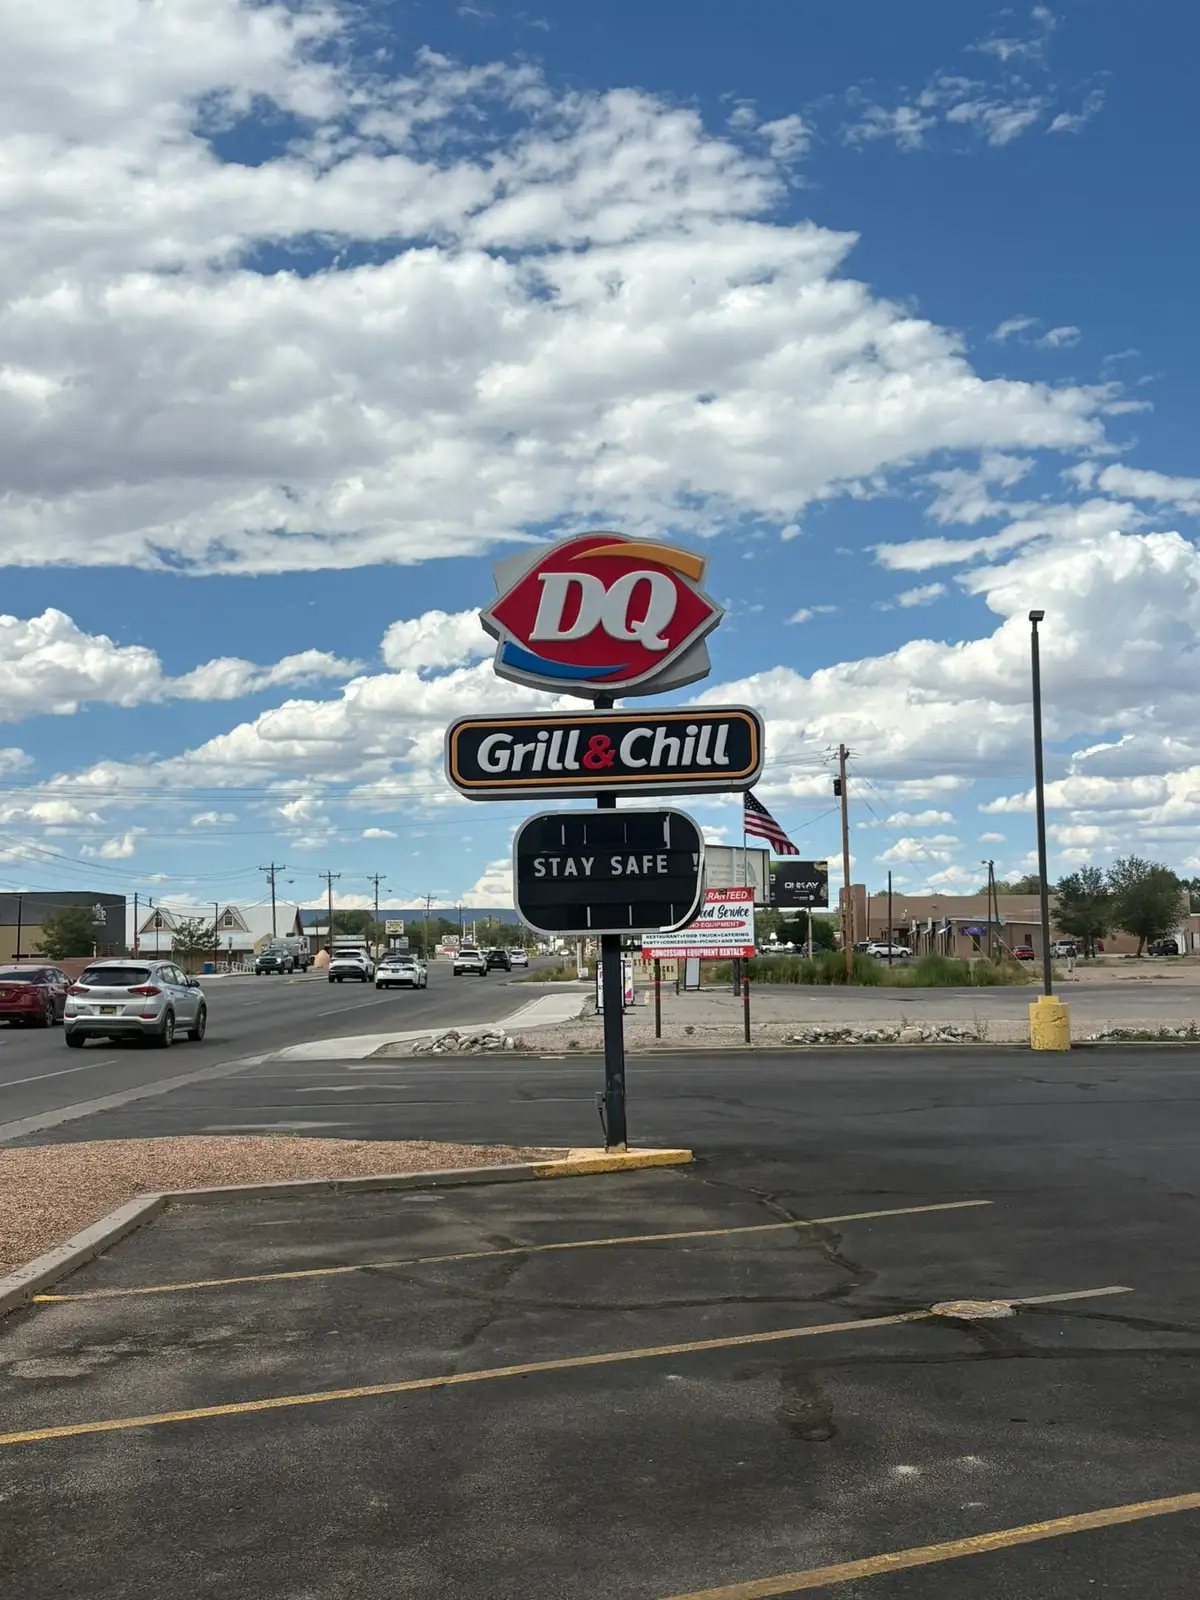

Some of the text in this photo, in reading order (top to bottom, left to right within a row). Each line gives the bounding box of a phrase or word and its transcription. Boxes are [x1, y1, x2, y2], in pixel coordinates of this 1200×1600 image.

[528, 570, 677, 651] DQ
[477, 730, 580, 773] Grill
[619, 723, 729, 768] Chill
[533, 857, 594, 877] STAY
[610, 855, 668, 875] SAFE
[706, 890, 748, 901] RANTEED
[717, 904, 750, 919] Service
